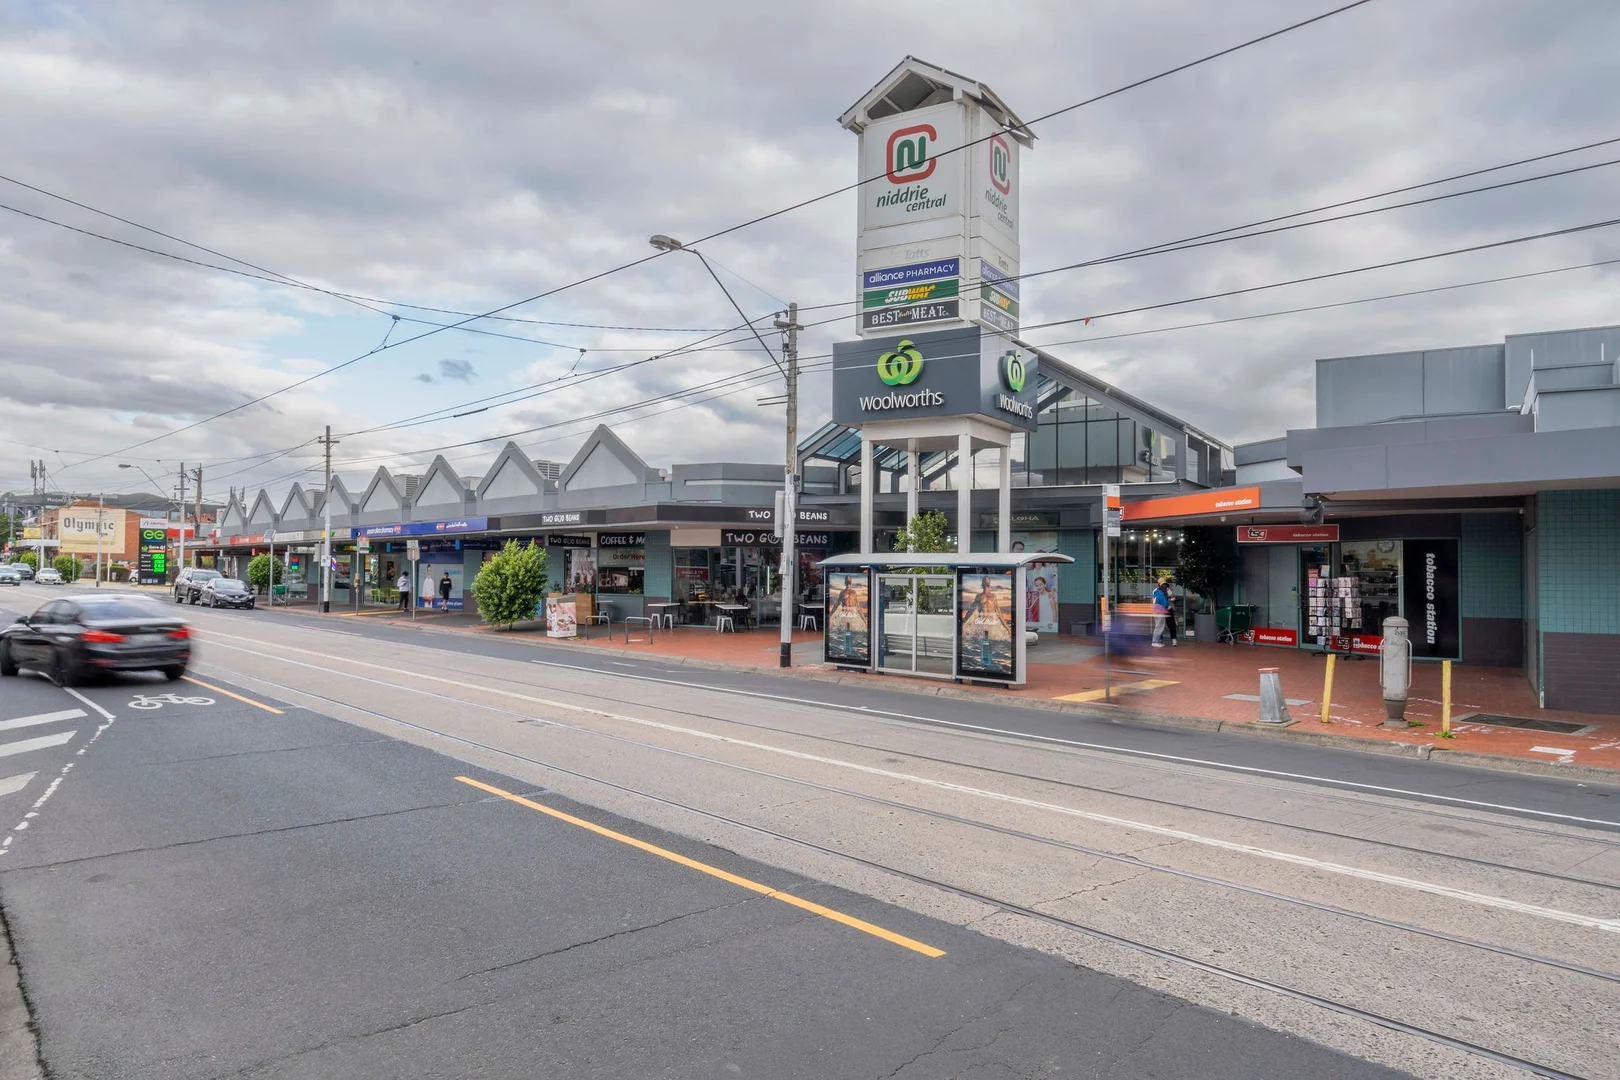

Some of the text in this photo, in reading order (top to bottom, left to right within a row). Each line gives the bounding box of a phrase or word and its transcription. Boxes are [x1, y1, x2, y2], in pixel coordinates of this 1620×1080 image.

[876, 185, 929, 208] niddrie
[906, 194, 947, 212] central
[985, 188, 1008, 214] niddrie
[997, 210, 1014, 229] central
[904, 249, 930, 260] Tatts
[869, 264, 955, 284] alliance PHARMACY
[885, 284, 936, 304] SUBWAY
[989, 291, 1011, 310] SUBWAY
[872, 310, 900, 325] BEST
[911, 306, 944, 320] MEAT
[859, 388, 944, 411] Woolworths
[1000, 393, 1033, 419] Woolworths
[543, 515, 554, 523] TWO
[565, 513, 580, 522] BEANS
[749, 510, 771, 519] TWO
[799, 511, 828, 520] BEANS
[600, 535, 627, 545] COFFEE
[629, 535, 634, 545] &
[726, 532, 755, 543] TWO
[793, 534, 828, 544] BEANS
[1426, 552, 1438, 645] tobacco station
[1259, 633, 1276, 641] tobacco
